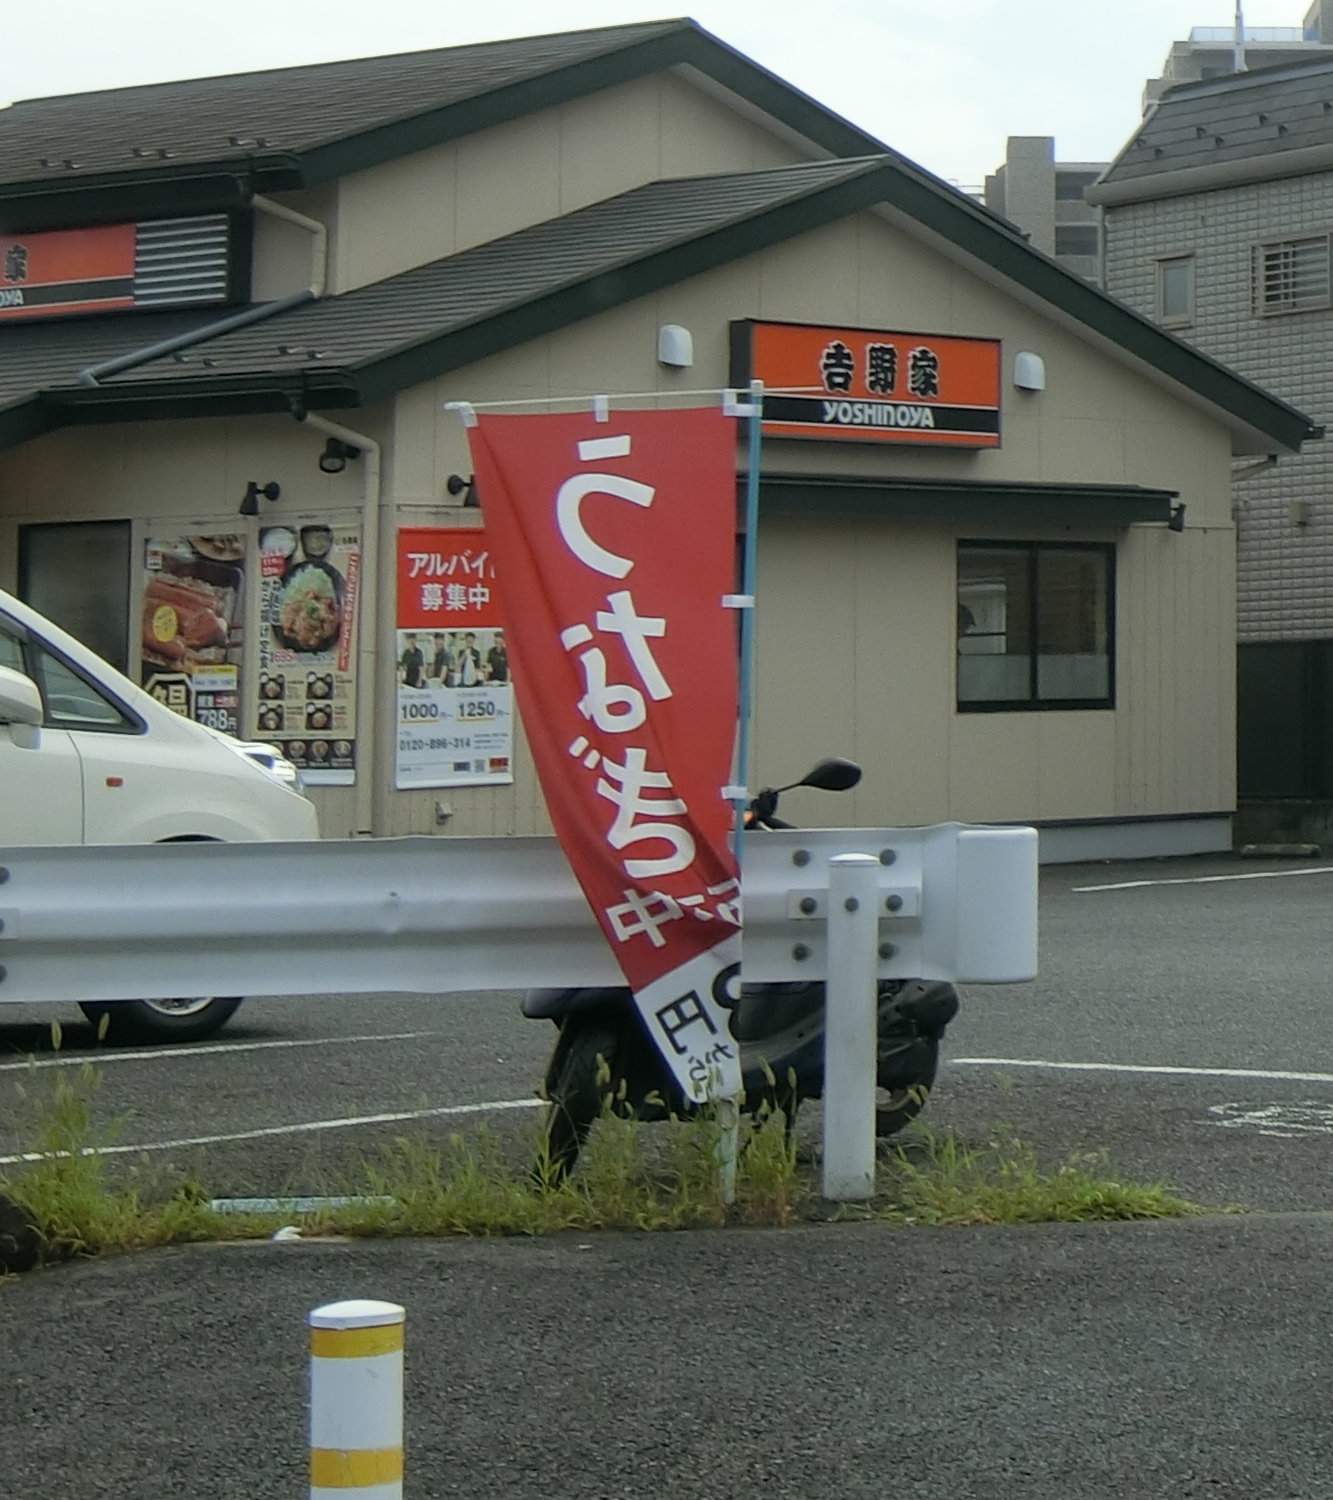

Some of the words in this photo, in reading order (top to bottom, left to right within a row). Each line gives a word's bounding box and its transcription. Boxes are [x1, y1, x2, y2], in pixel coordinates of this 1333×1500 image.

[823, 401, 935, 429] YOSHINOYA
[421, 582, 490, 612] 募集中
